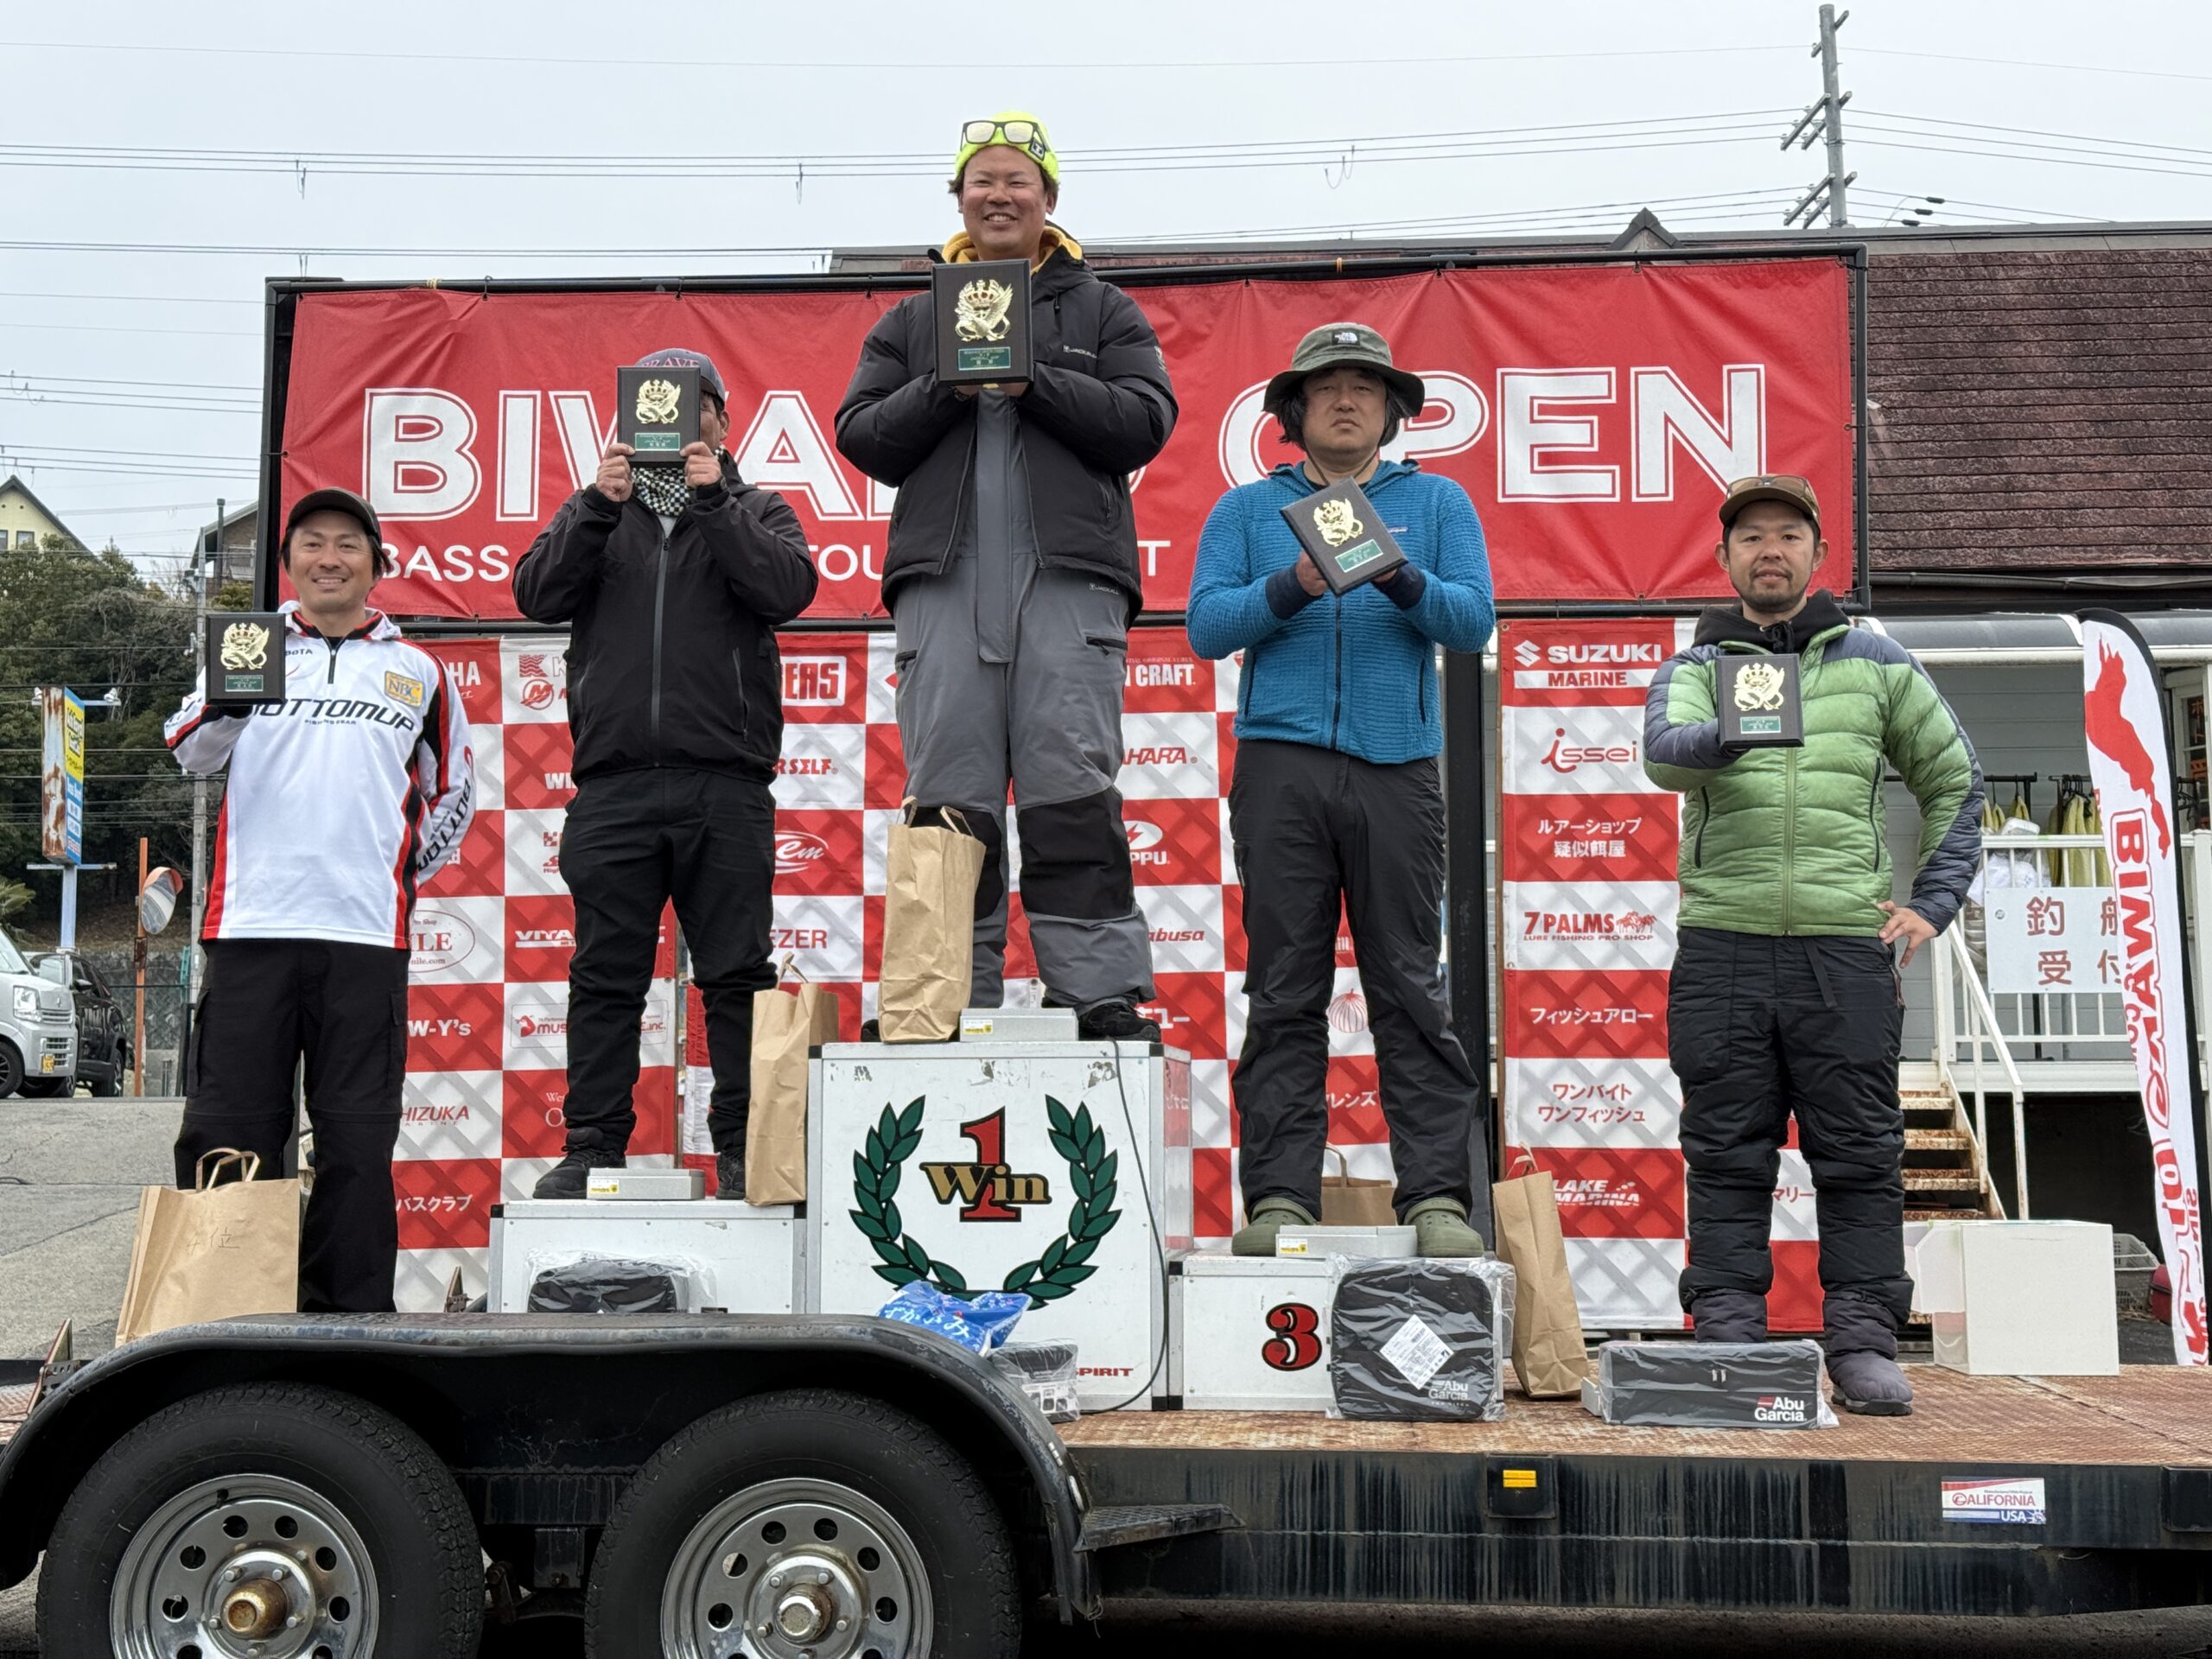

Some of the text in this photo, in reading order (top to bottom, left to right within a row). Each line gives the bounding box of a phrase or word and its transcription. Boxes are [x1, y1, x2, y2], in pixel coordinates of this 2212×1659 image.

[1548, 644, 1662, 664] SUZUKI
[448, 661, 481, 687] HA
[1548, 671, 1628, 687] MARINE
[253, 697, 416, 733] OTTOMUP
[1541, 728, 1637, 773] issei
[1537, 817, 1642, 836] ルアーショップ
[1129, 850, 1167, 865] PPU
[1554, 840, 1626, 858] 疑似餌屋
[1524, 912, 1615, 935] 7 PALMS
[1529, 1007, 1654, 1025] フィッシュアロー
[1325, 1090, 1377, 1109] レンズ
[1553, 1083, 1632, 1102] ワンバイト
[401, 1105, 470, 1122] HIZUKA
[1538, 1106, 1646, 1123] ワンフィッシュ
[919, 1161, 1052, 1205] Win
[1553, 1179, 1609, 1192] LAKE
[1554, 1193, 1640, 1207] MARINA
[1772, 1186, 1815, 1203] マリー
[1262, 1302, 1322, 1372] 3
[1443, 1380, 1469, 1392] Abu
[1772, 1395, 1805, 1411] Abu
[1952, 1492, 2036, 1507] CALIFORNIA
[2000, 1510, 2027, 1522] USA
